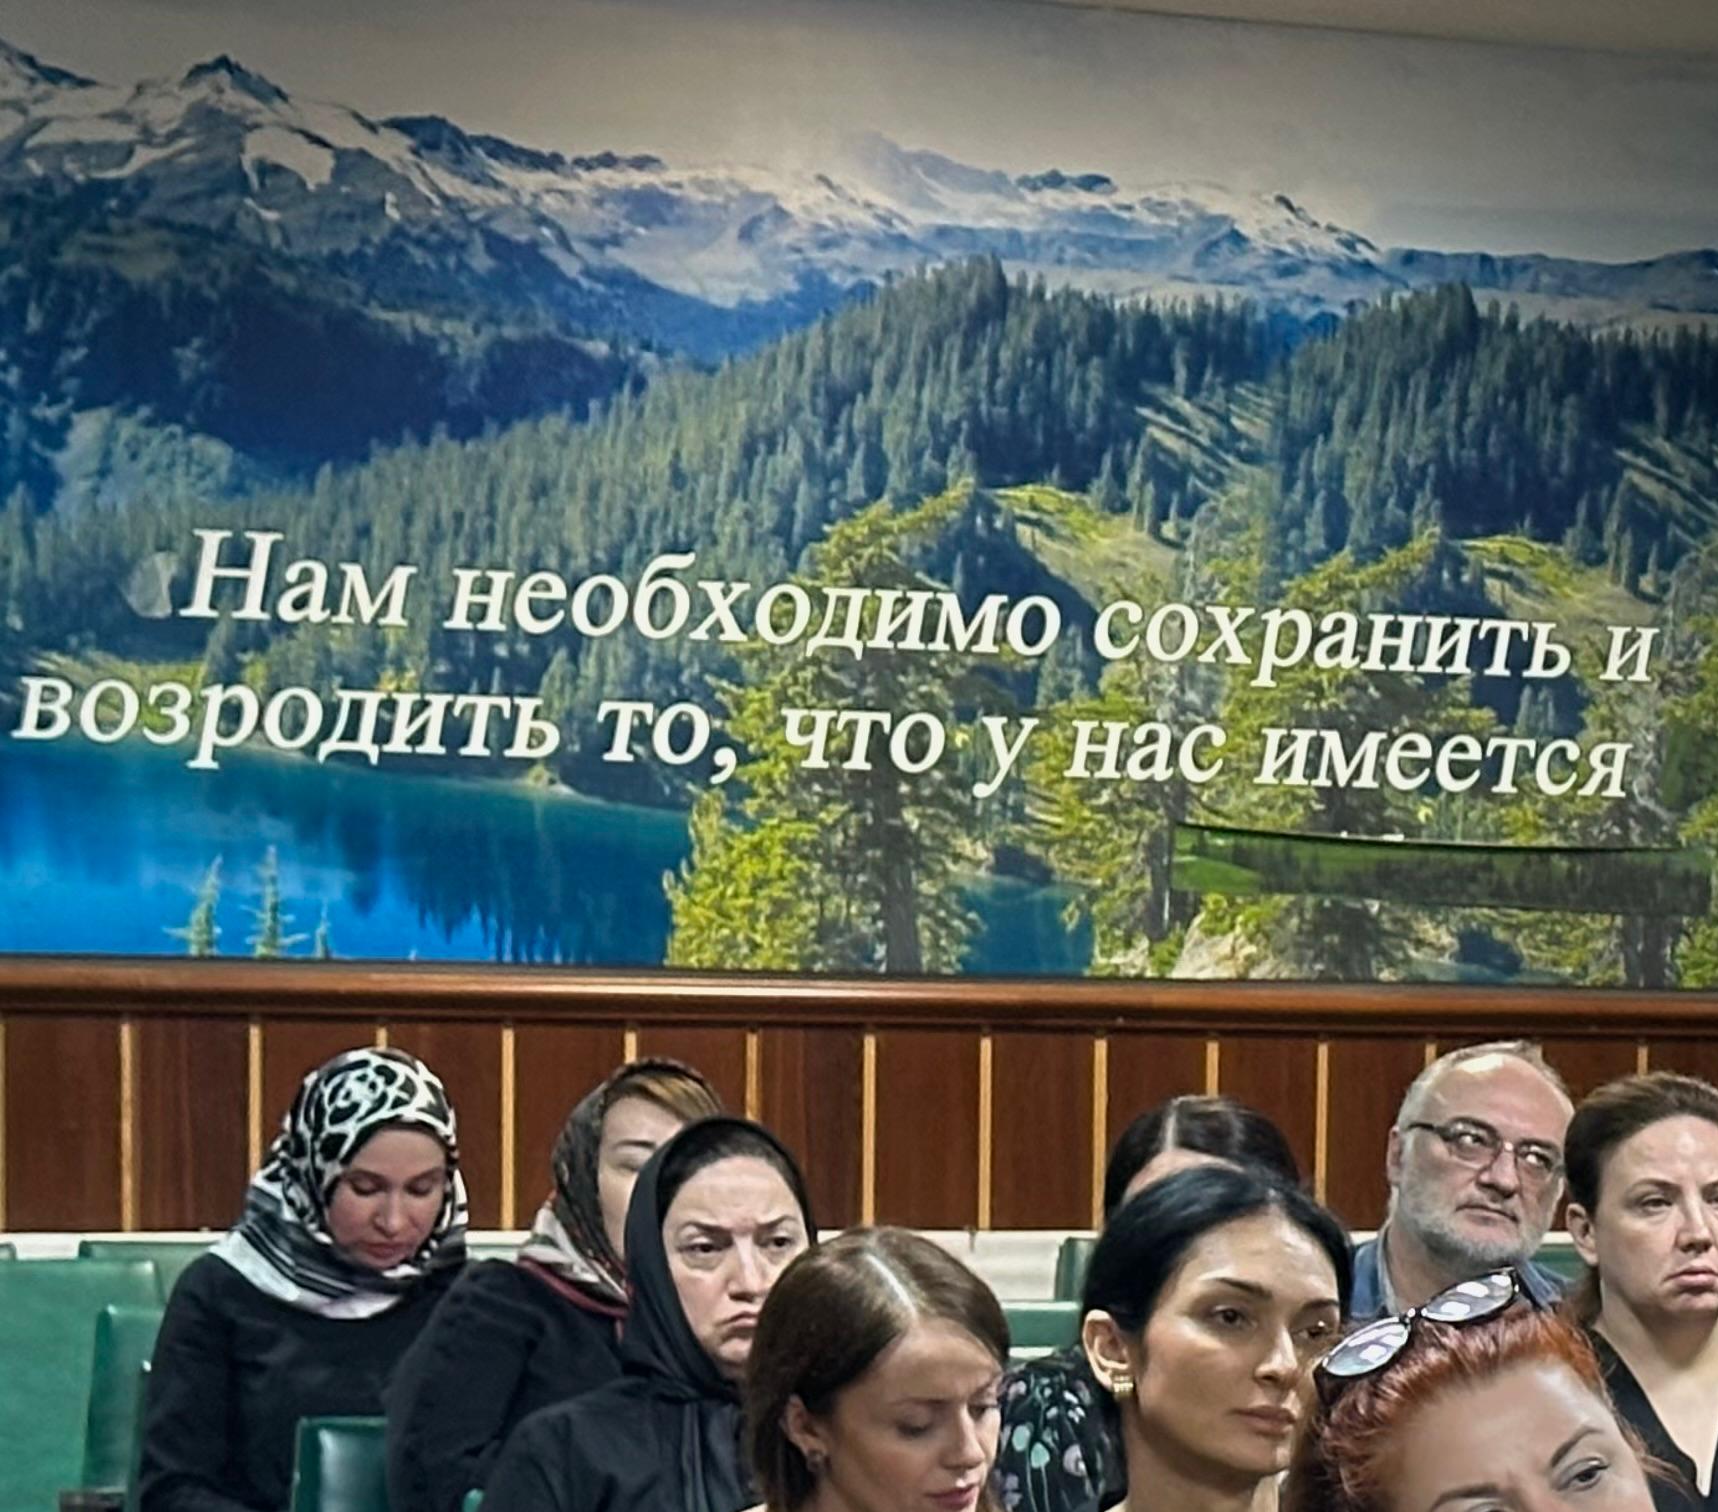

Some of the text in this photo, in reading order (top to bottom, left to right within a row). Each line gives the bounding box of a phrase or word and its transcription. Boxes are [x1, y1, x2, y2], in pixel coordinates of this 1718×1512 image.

[178, 528, 1661, 688] Нам необходимо сохранить и
[12, 676, 1633, 799] возродить то, что у нас имеется
